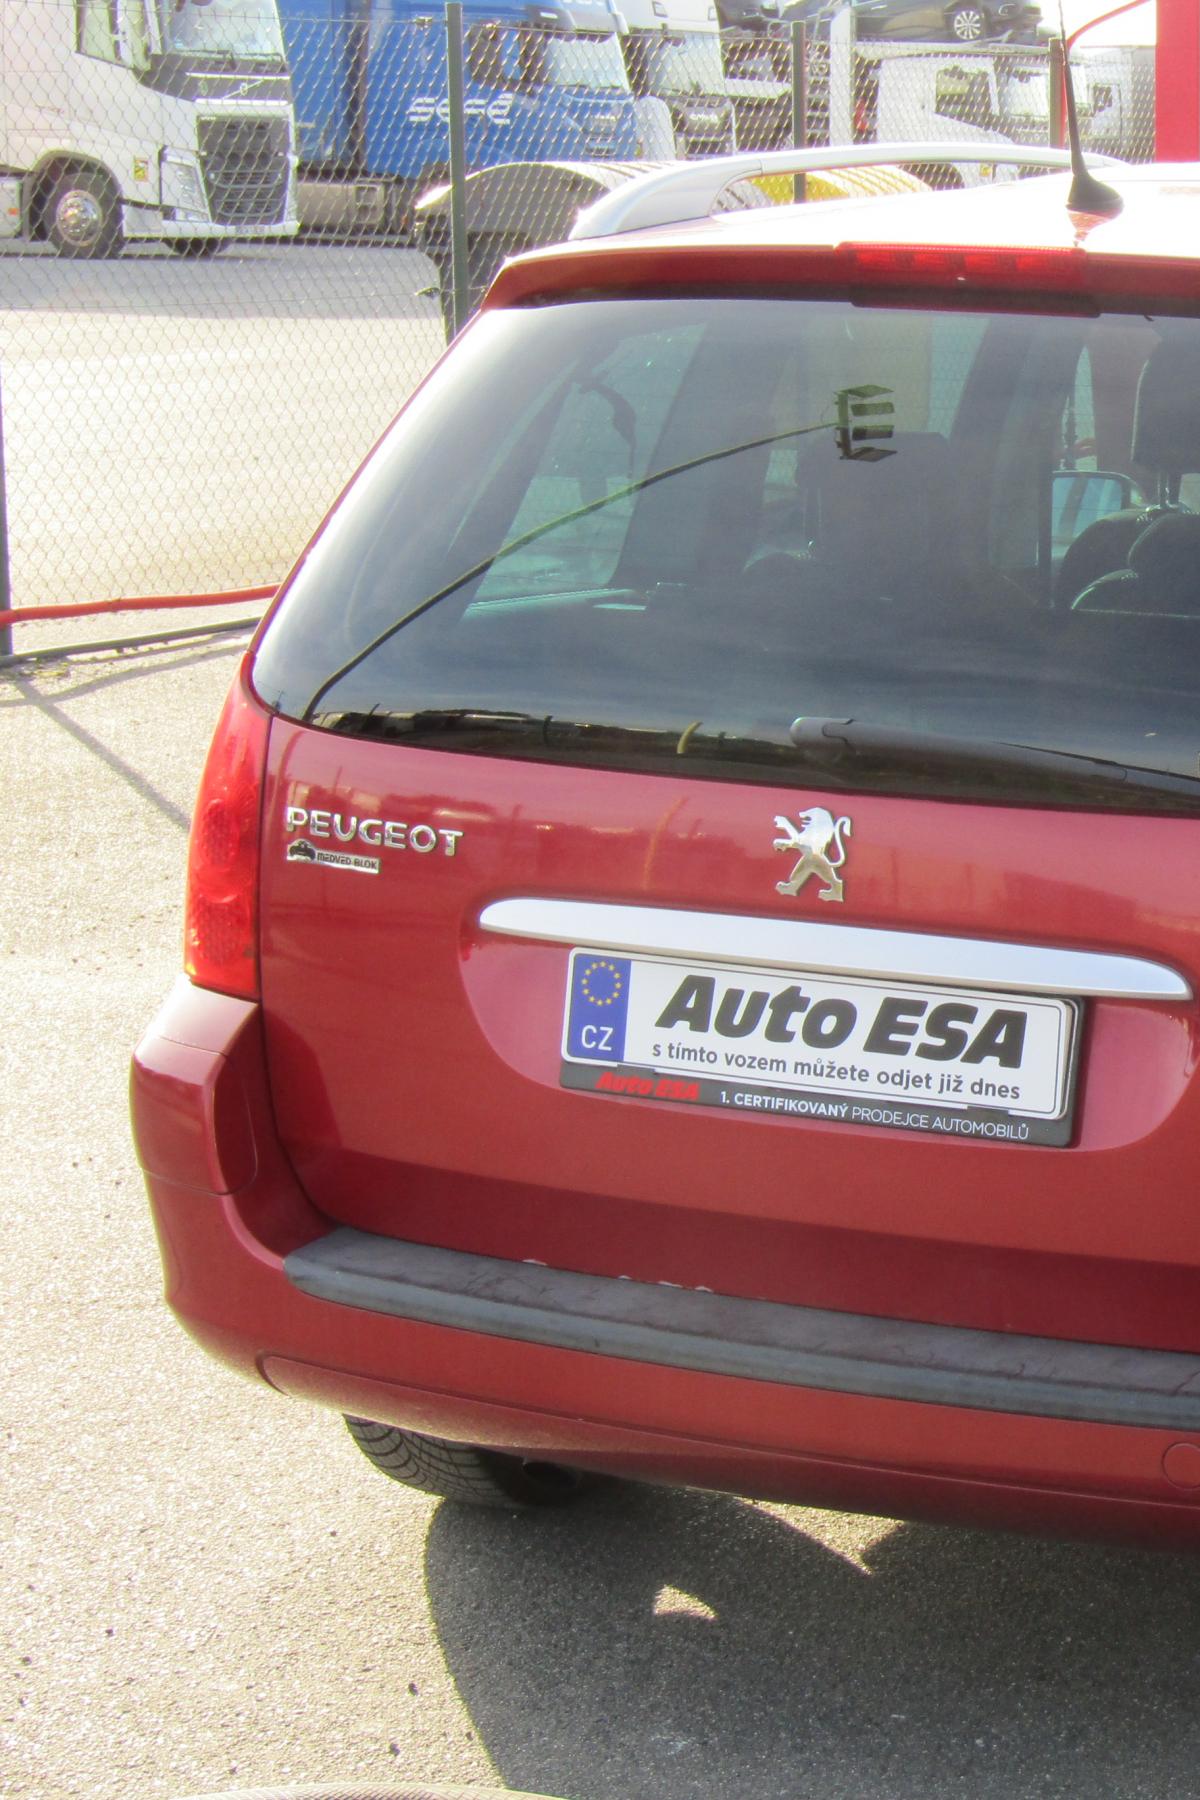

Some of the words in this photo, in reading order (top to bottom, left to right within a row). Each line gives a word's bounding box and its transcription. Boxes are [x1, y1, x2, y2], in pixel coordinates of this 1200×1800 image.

[286, 806, 464, 857] PEUGEOT
[581, 1025, 614, 1051] CZ
[654, 974, 858, 1049] Auto
[862, 996, 1028, 1069] ESA
[652, 1042, 662, 1058] s
[667, 1042, 718, 1065] tímto
[724, 1052, 787, 1073] vozem
[793, 1058, 870, 1083] můžete
[876, 1070, 933, 1090] odjet
[937, 1074, 964, 1094] již
[970, 1078, 1021, 1100] dnes
[654, 1078, 700, 1102] ESA
[720, 1091, 730, 1104] 1.
[734, 1092, 849, 1118] CERTIFIKOVANÝ
[851, 1106, 929, 1129] PRODEJCE
[932, 1116, 1029, 1140] AUTOMOBILŮ
